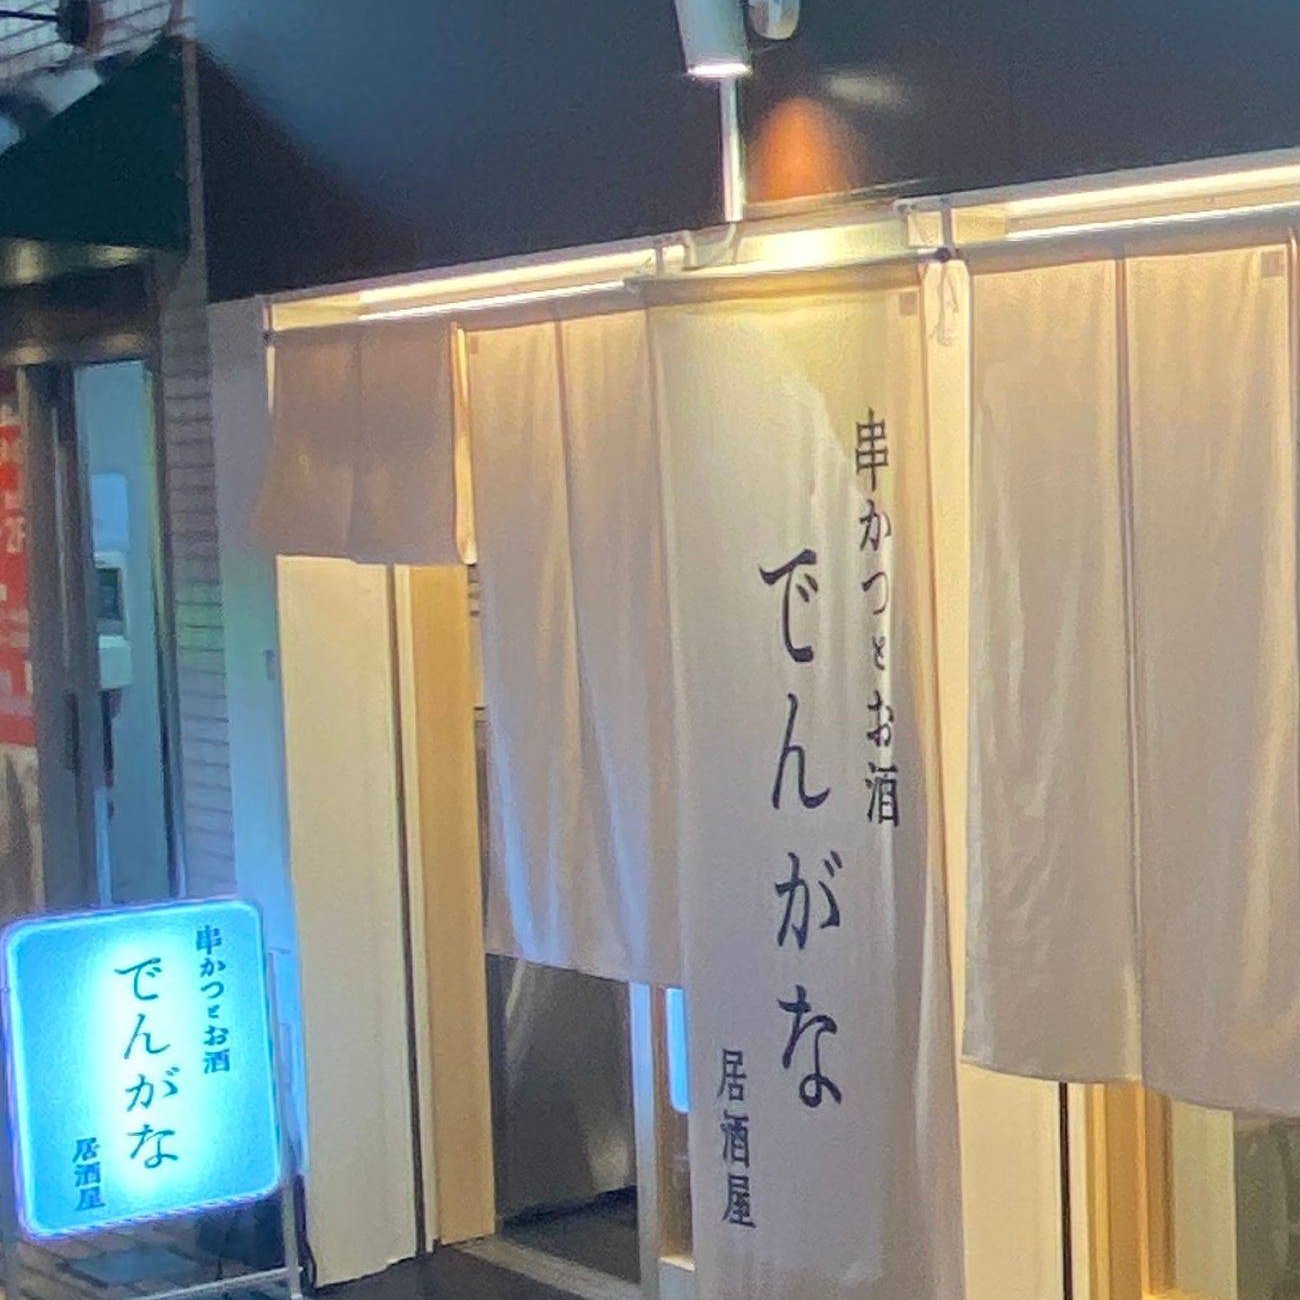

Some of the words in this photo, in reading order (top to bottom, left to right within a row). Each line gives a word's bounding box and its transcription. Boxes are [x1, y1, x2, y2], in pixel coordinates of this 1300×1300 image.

[855, 408, 899, 828] 串かつとお酒
[759, 549, 842, 1108] でんがな
[114, 957, 180, 1169] でんがな
[196, 925, 231, 1074] 串かつとお酒
[72, 1137, 106, 1212] 居酒屋
[717, 1049, 756, 1229] 居酒屋
